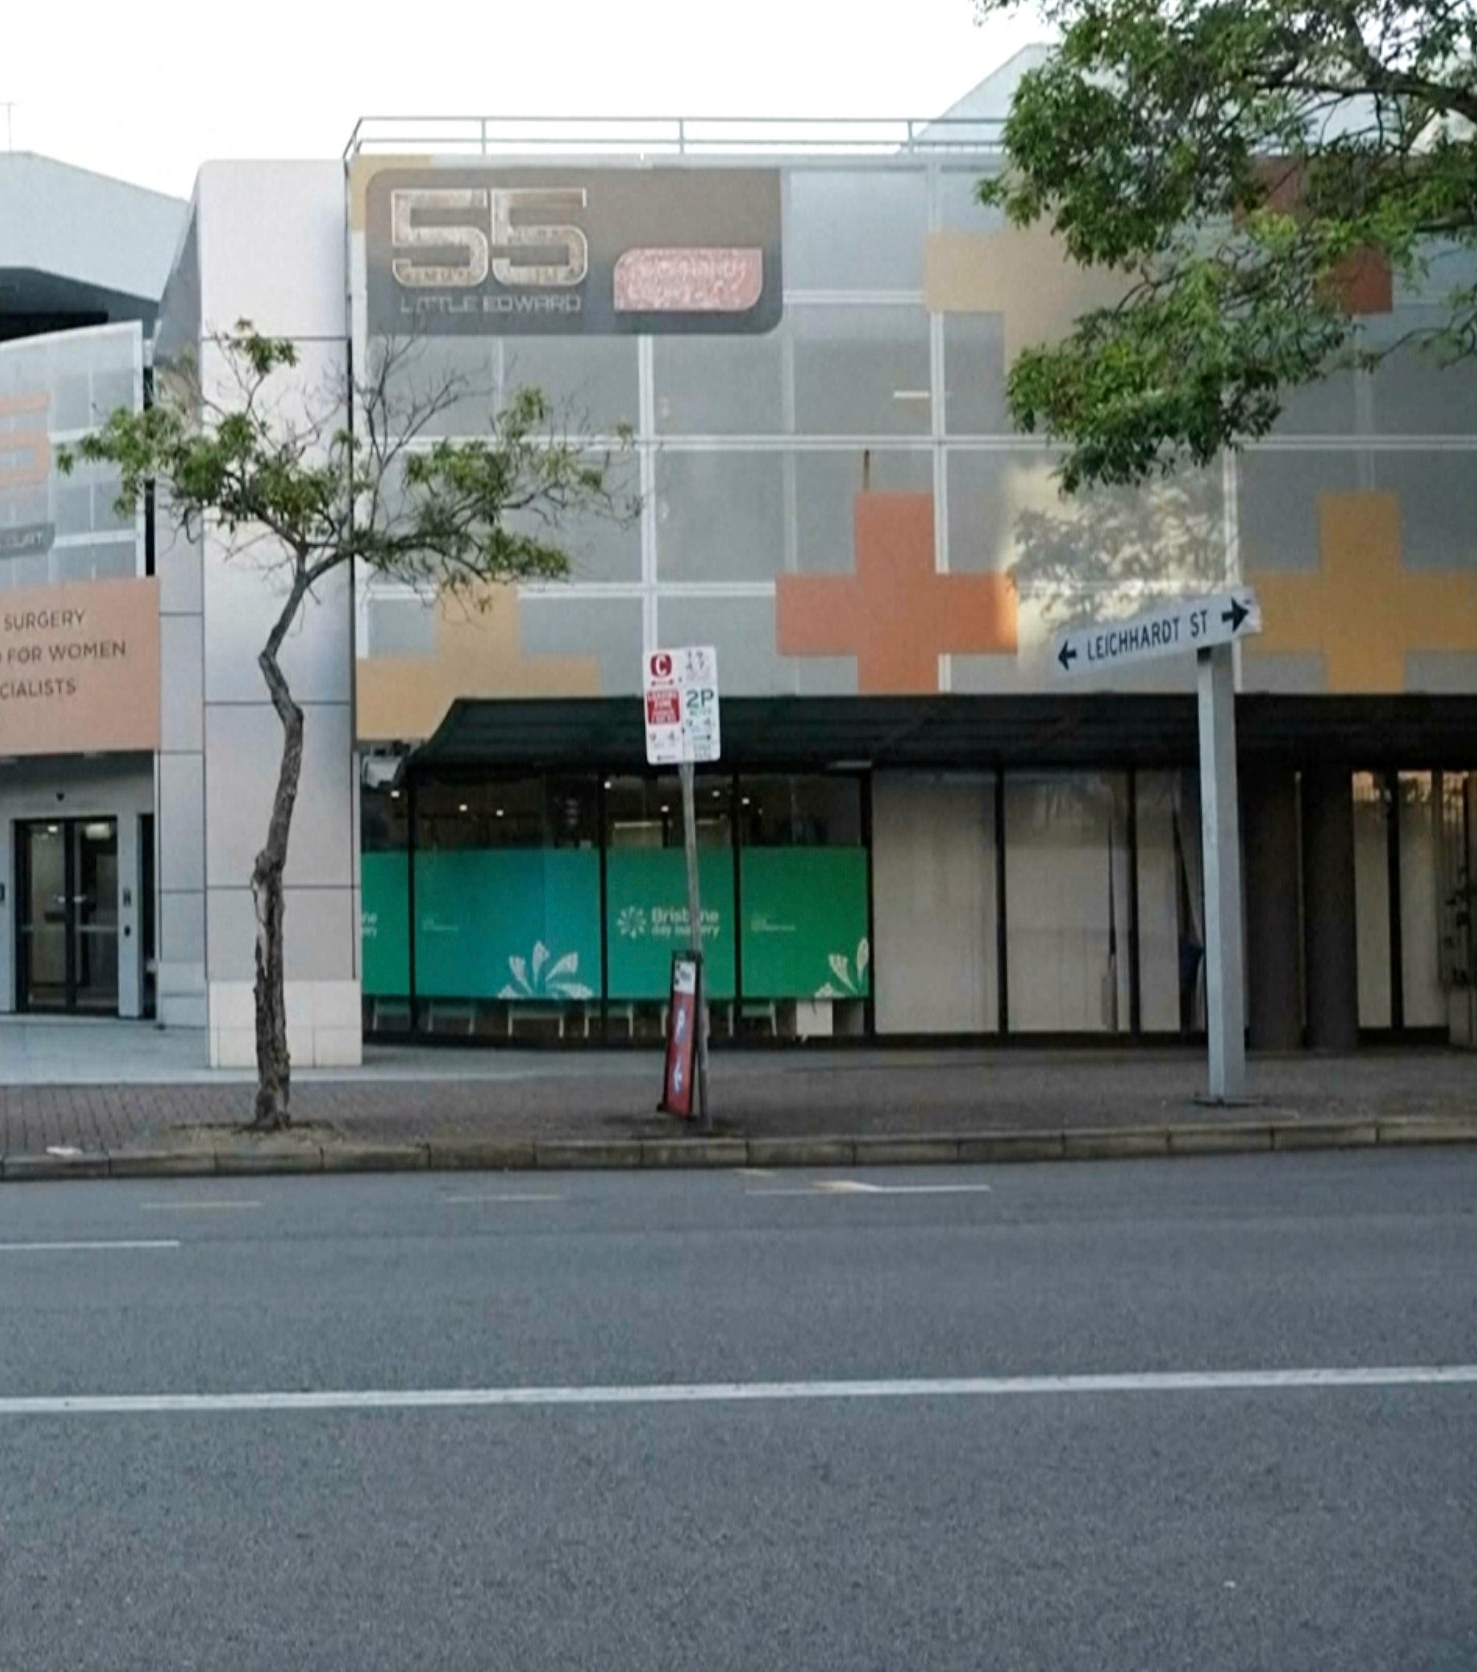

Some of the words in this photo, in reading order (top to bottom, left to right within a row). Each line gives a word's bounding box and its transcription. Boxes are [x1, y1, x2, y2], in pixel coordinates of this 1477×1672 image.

[391, 188, 587, 287] 55
[400, 296, 477, 313] LITTLE
[483, 296, 581, 312] EDWARD
[4, 609, 86, 632] SURGERY
[1088, 617, 1180, 661] LEICHHARDT
[1190, 610, 1208, 638] ST
[7, 647, 42, 664] FOR
[48, 640, 126, 662] WOMEN
[687, 689, 714, 708] 2P
[651, 906, 719, 923] Brisbne
